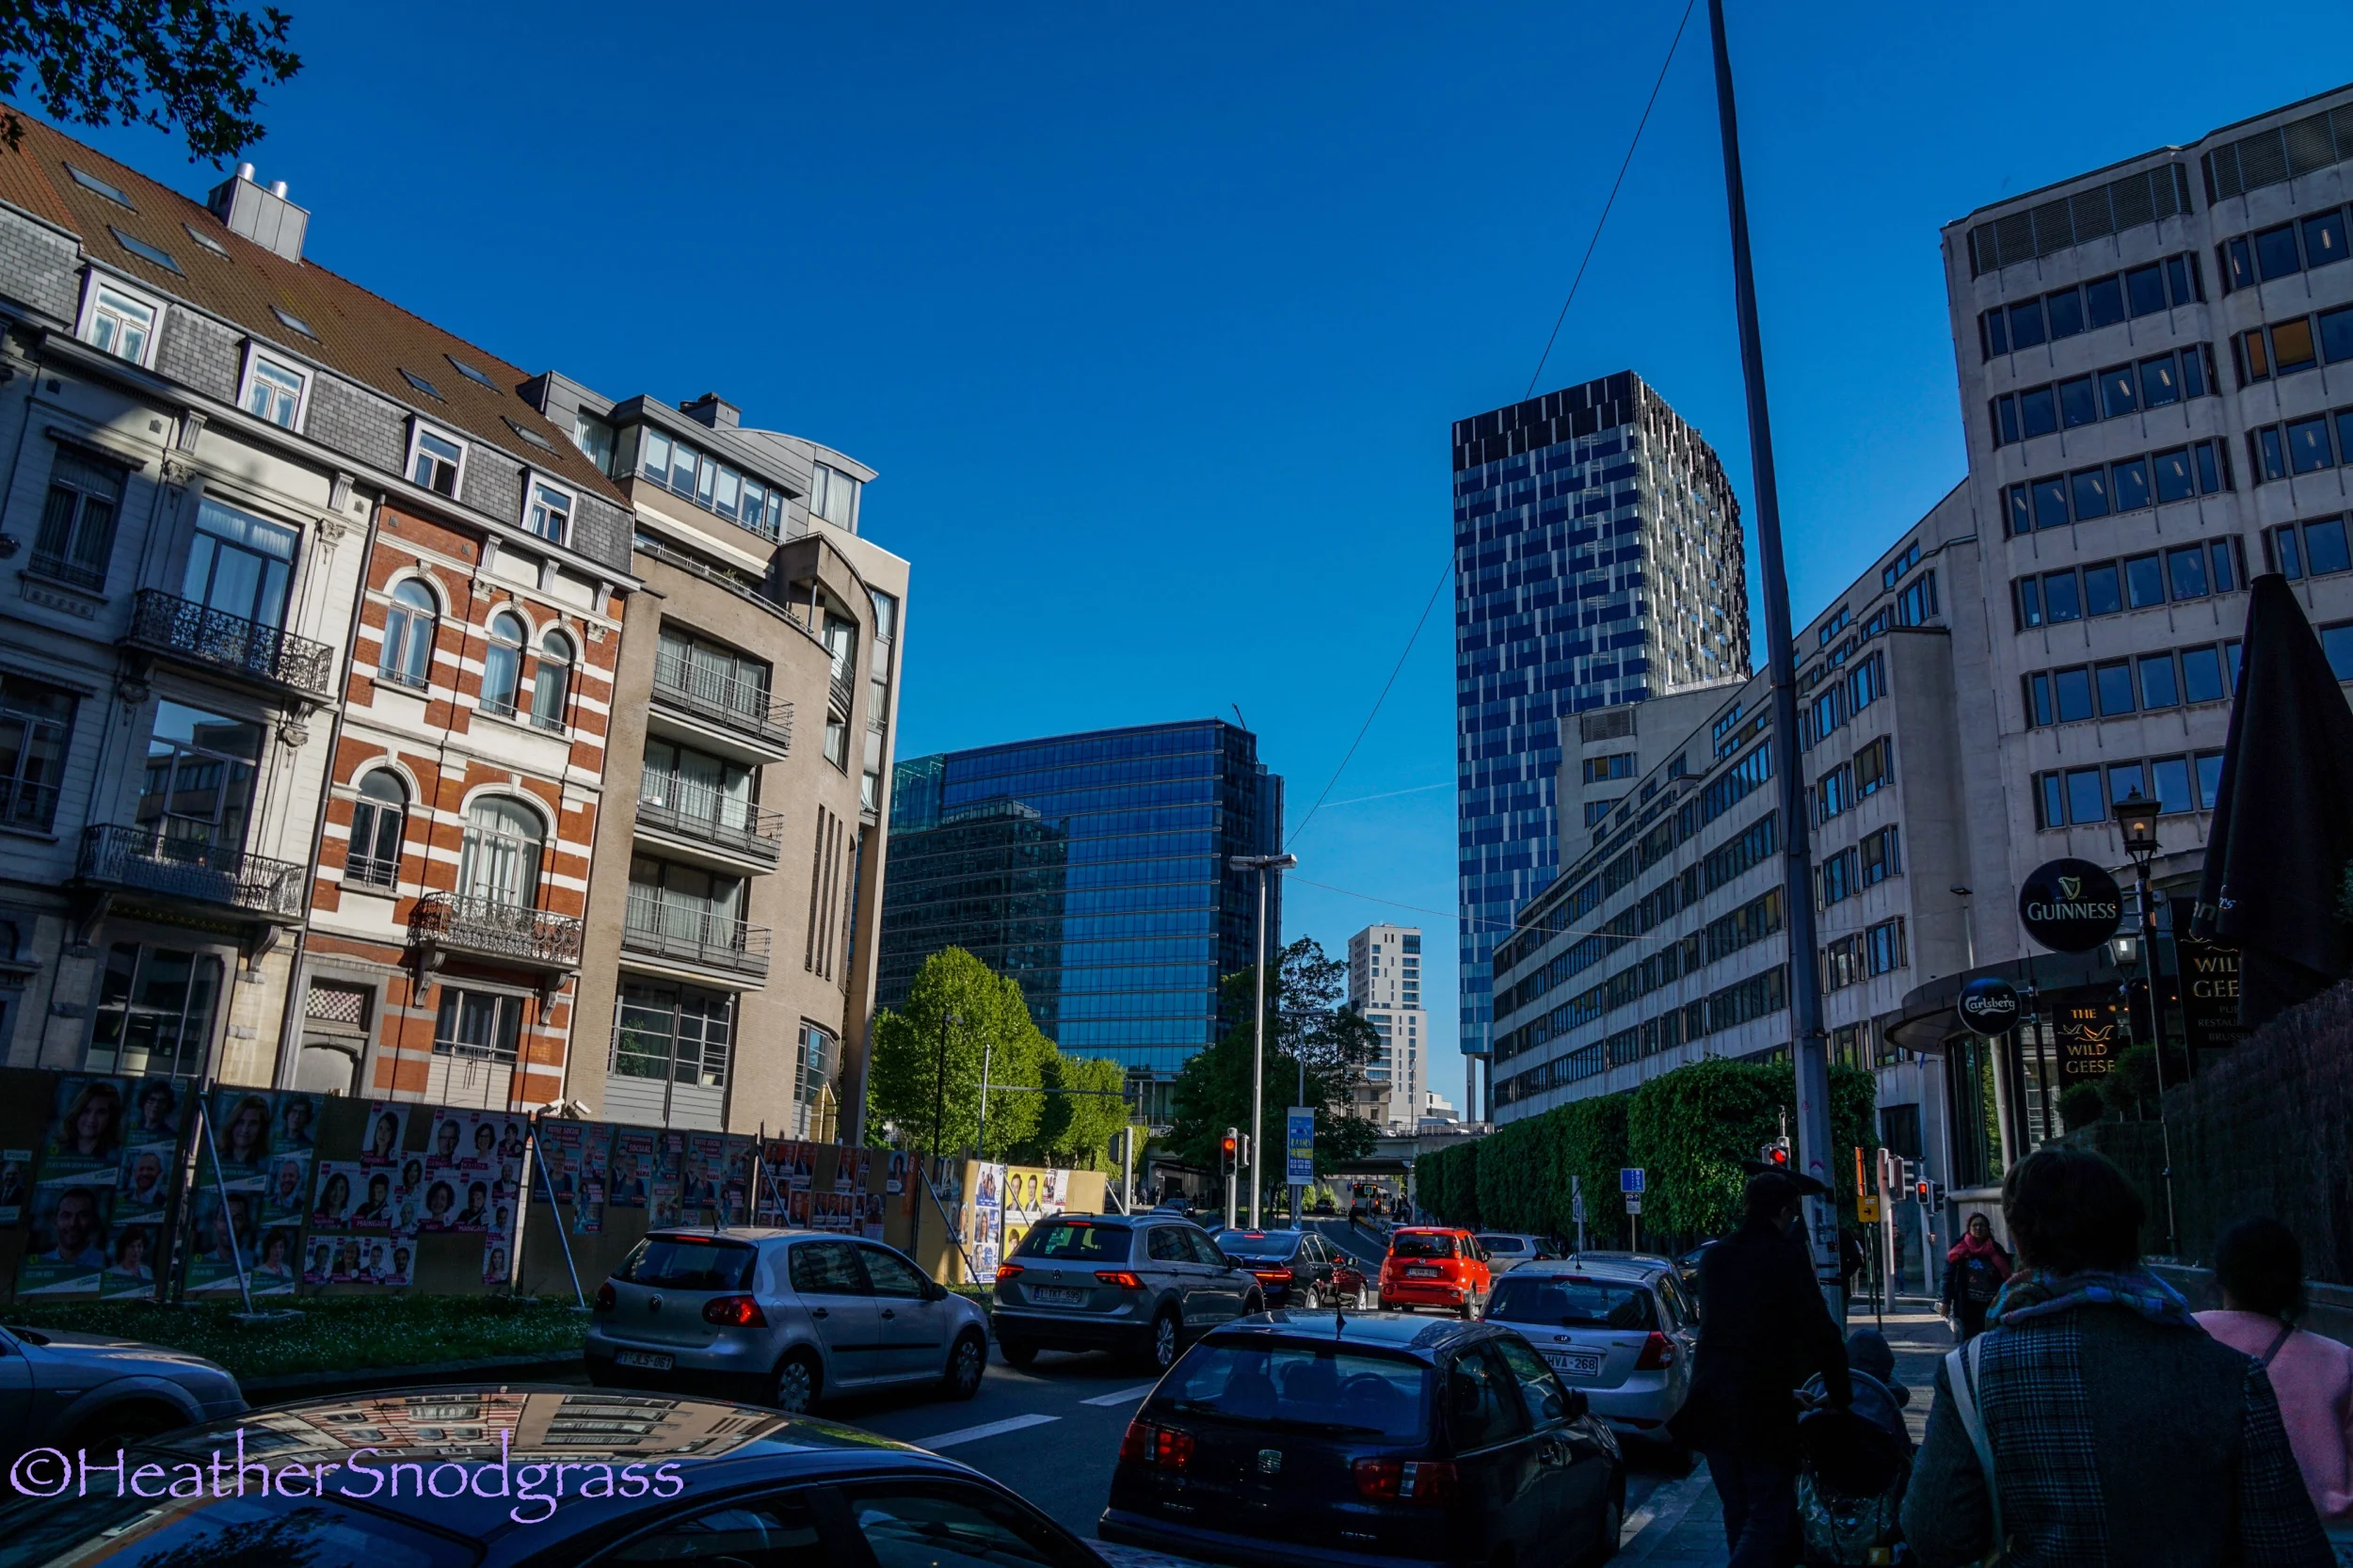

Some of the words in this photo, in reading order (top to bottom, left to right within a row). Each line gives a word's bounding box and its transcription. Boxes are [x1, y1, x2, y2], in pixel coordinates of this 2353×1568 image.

[2026, 902, 2117, 921] GUINNESS
[2193, 956, 2242, 973] WIL
[2192, 980, 2240, 999] GEE
[1965, 994, 2016, 1015] Carlsberg
[2071, 1008, 2097, 1019] THE
[2066, 1044, 2107, 1056] WILD
[2065, 1059, 2116, 1074] GEESE
[628, 1144, 652, 1153] SOCIAAL
